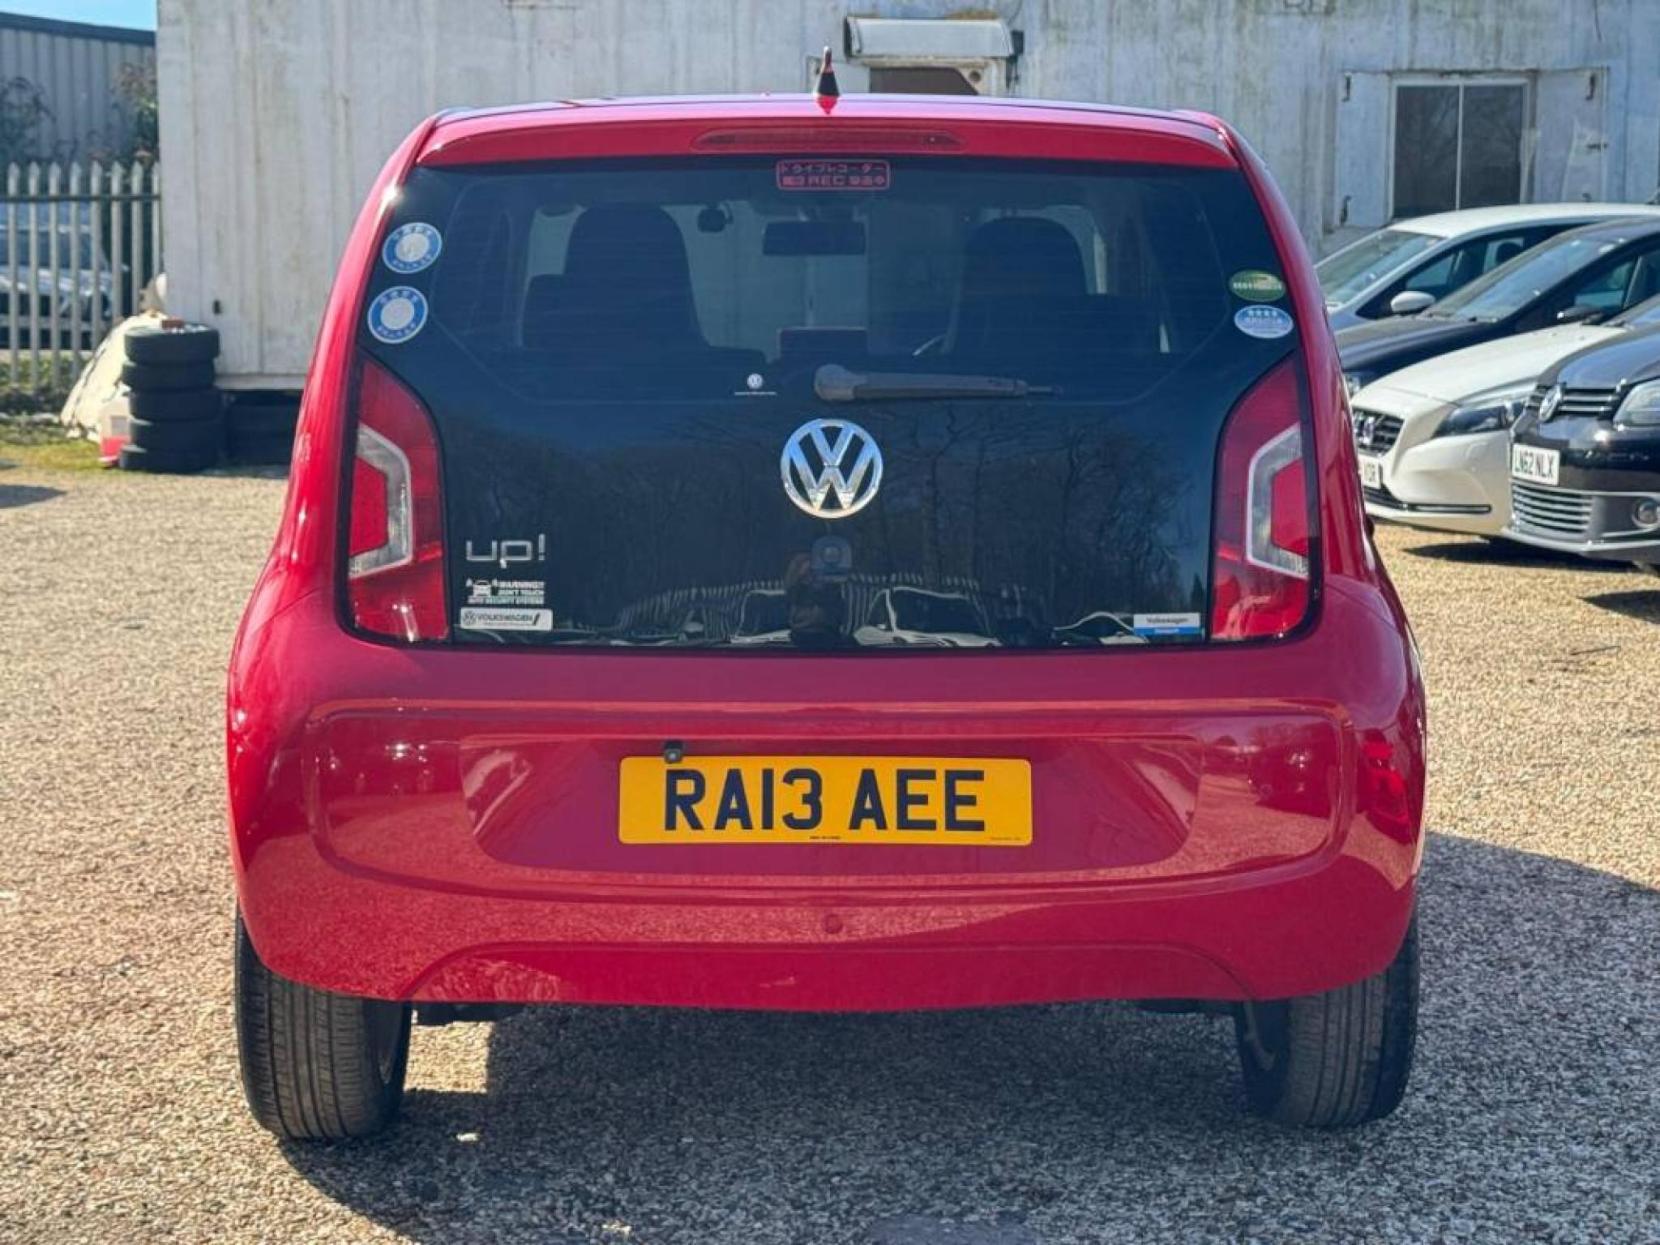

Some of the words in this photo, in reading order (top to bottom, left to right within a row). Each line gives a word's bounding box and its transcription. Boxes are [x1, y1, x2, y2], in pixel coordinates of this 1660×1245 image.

[1535, 453, 1554, 479] NLX
[466, 534, 545, 568] up!
[477, 612, 534, 621] VOLKSWAGEN
[664, 768, 823, 831] RA13
[848, 768, 985, 831] AEE
